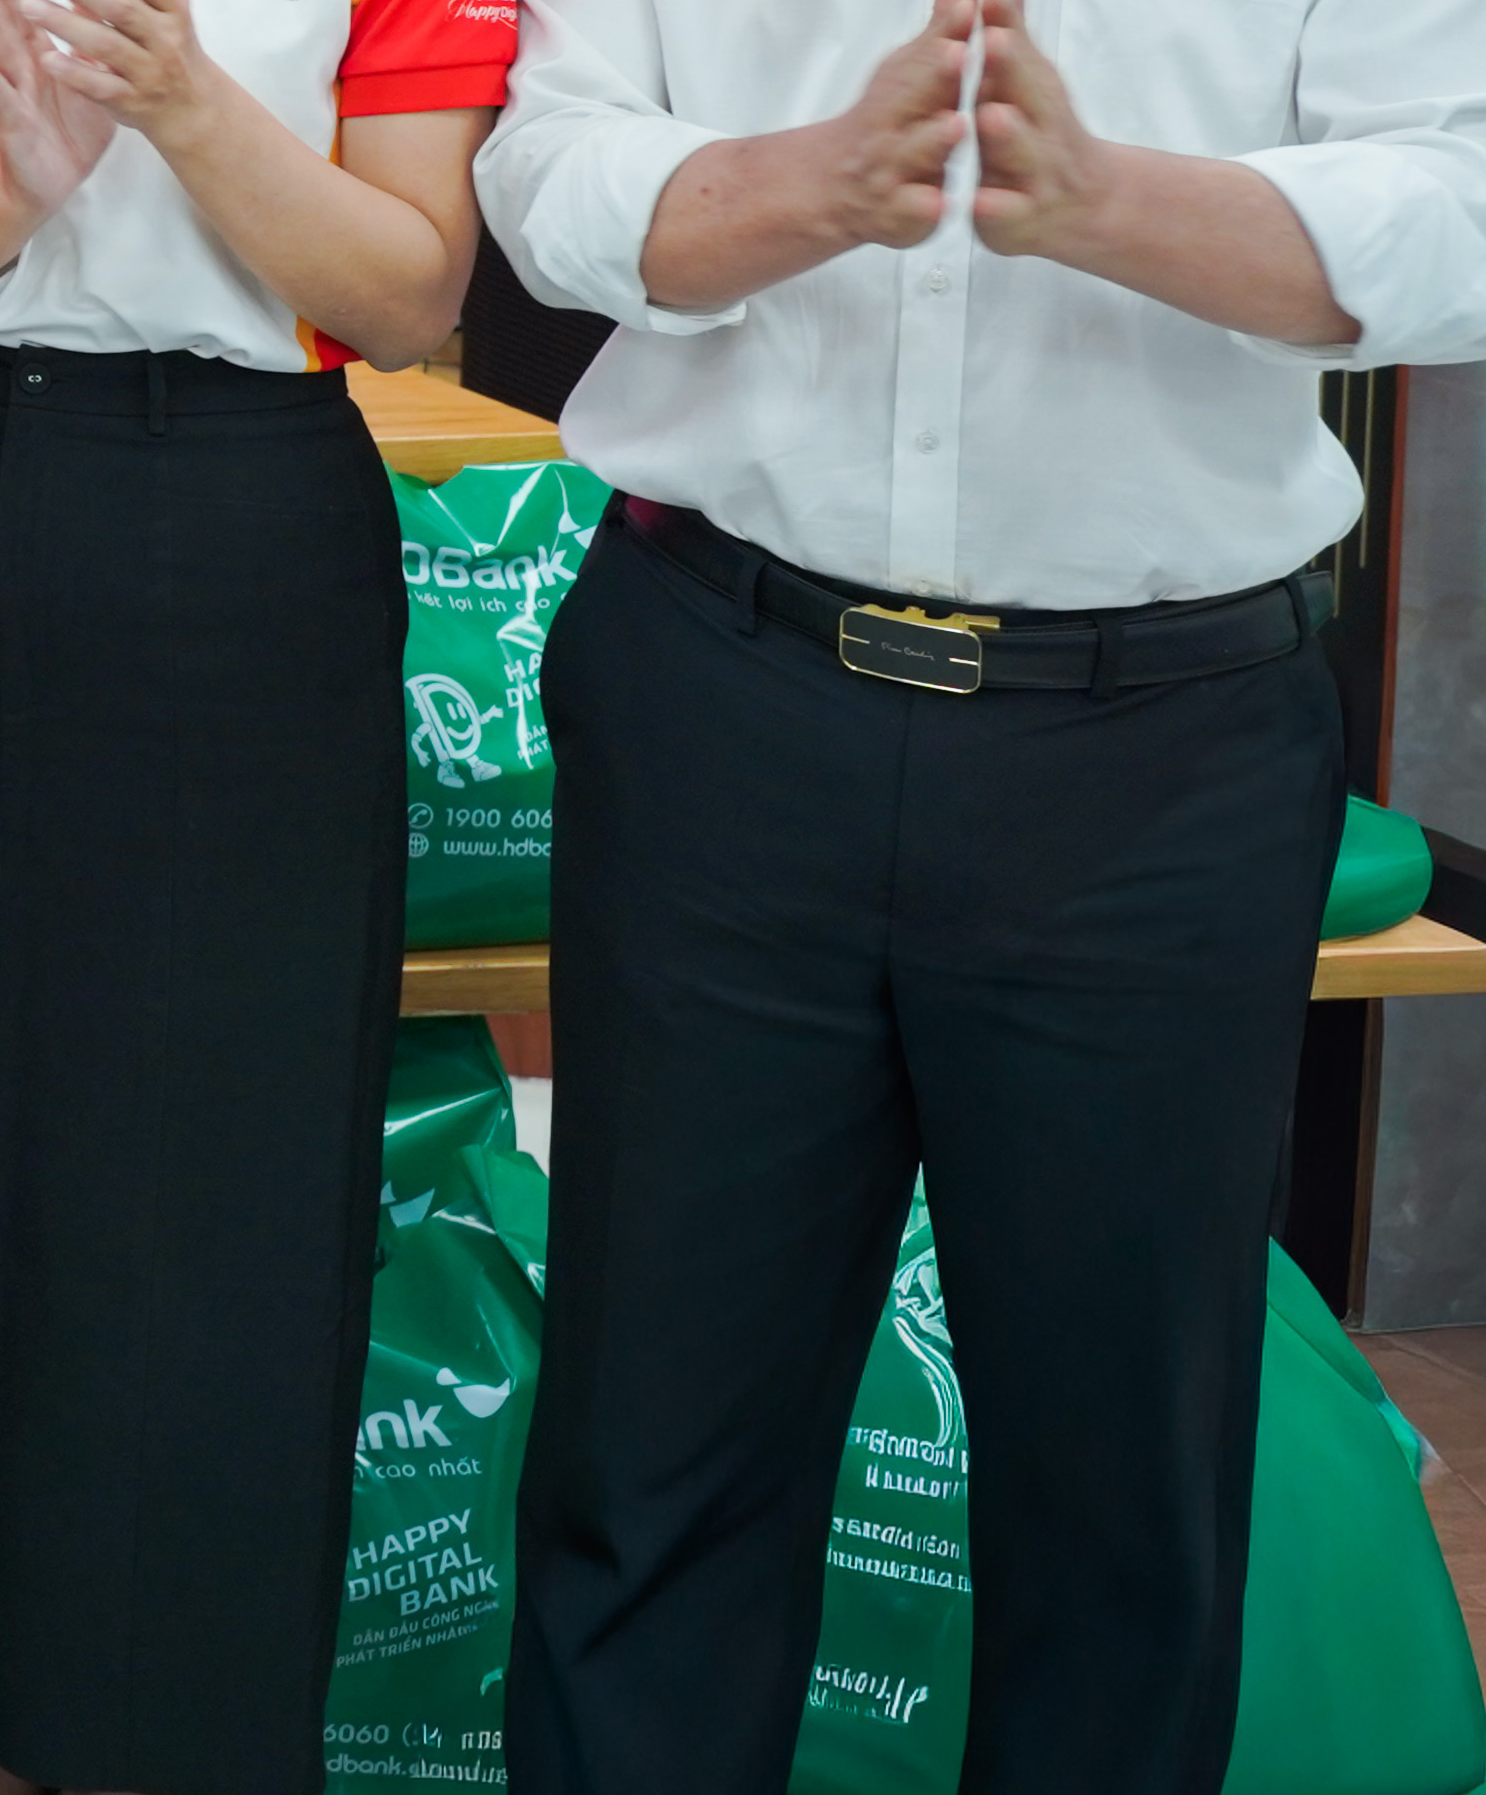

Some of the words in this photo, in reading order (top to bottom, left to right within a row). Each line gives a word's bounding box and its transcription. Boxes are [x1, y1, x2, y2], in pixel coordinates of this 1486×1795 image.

[401, 540, 578, 590] DBank
[446, 807, 501, 827] 1900
[510, 808, 552, 829] 606
[375, 1464, 416, 1479] cao
[428, 1456, 482, 1478] nhất
[352, 1507, 471, 1570] HAPPY
[347, 1542, 483, 1602] DIGITAL
[400, 1564, 499, 1616] BANK
[323, 1723, 390, 1744] 6060
